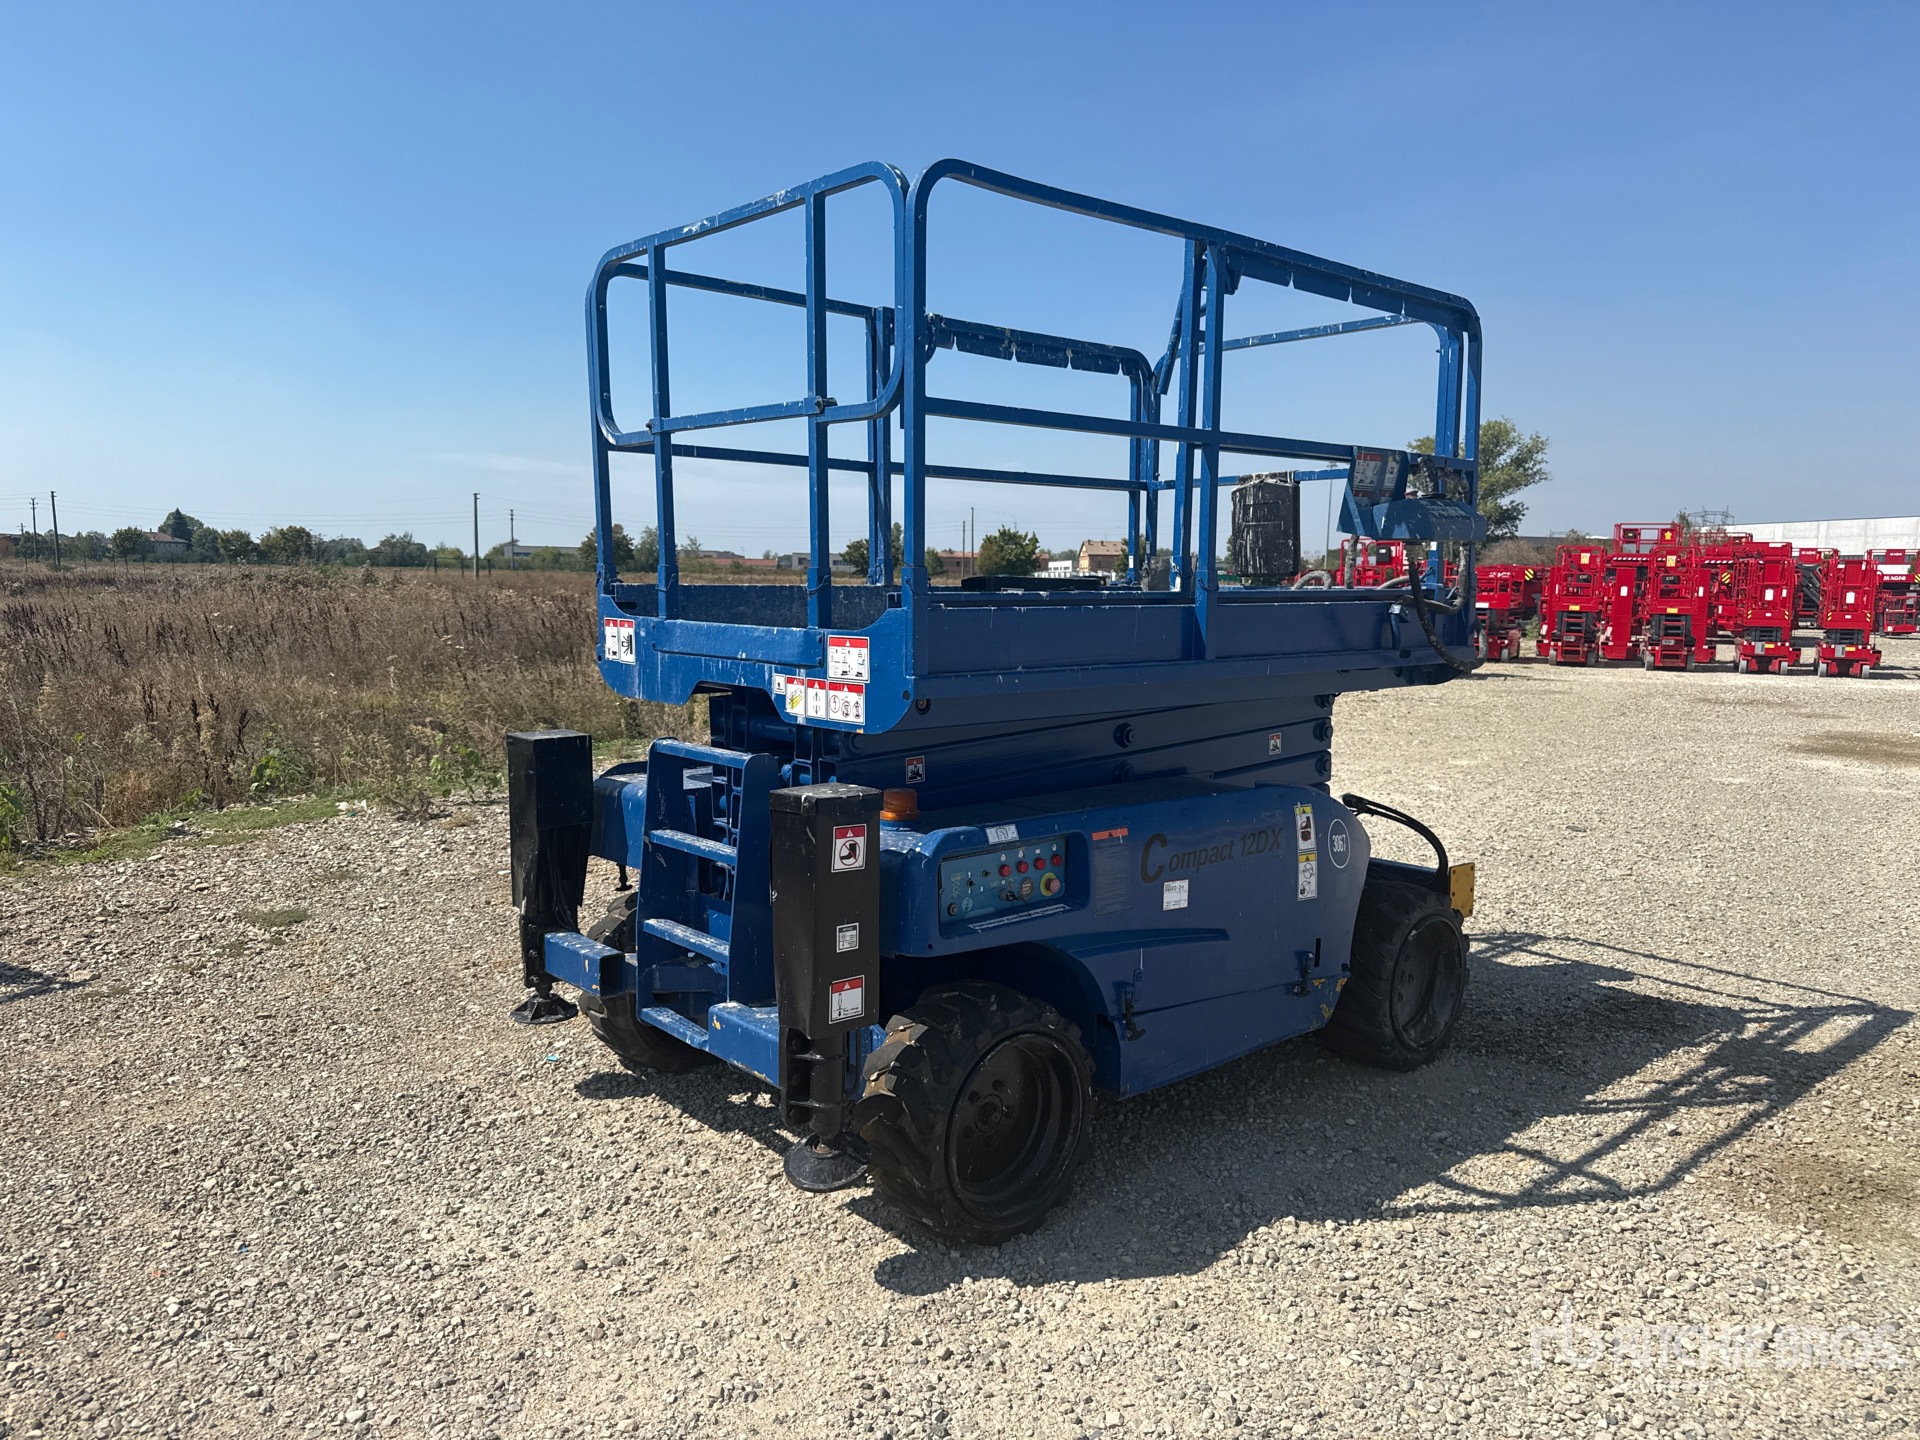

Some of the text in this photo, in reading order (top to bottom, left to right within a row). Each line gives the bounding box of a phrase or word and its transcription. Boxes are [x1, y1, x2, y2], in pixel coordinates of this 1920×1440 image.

[1141, 833, 1235, 884] Compact
[1240, 827, 1283, 857] 12DX
[1332, 834, 1346, 852] 3067
